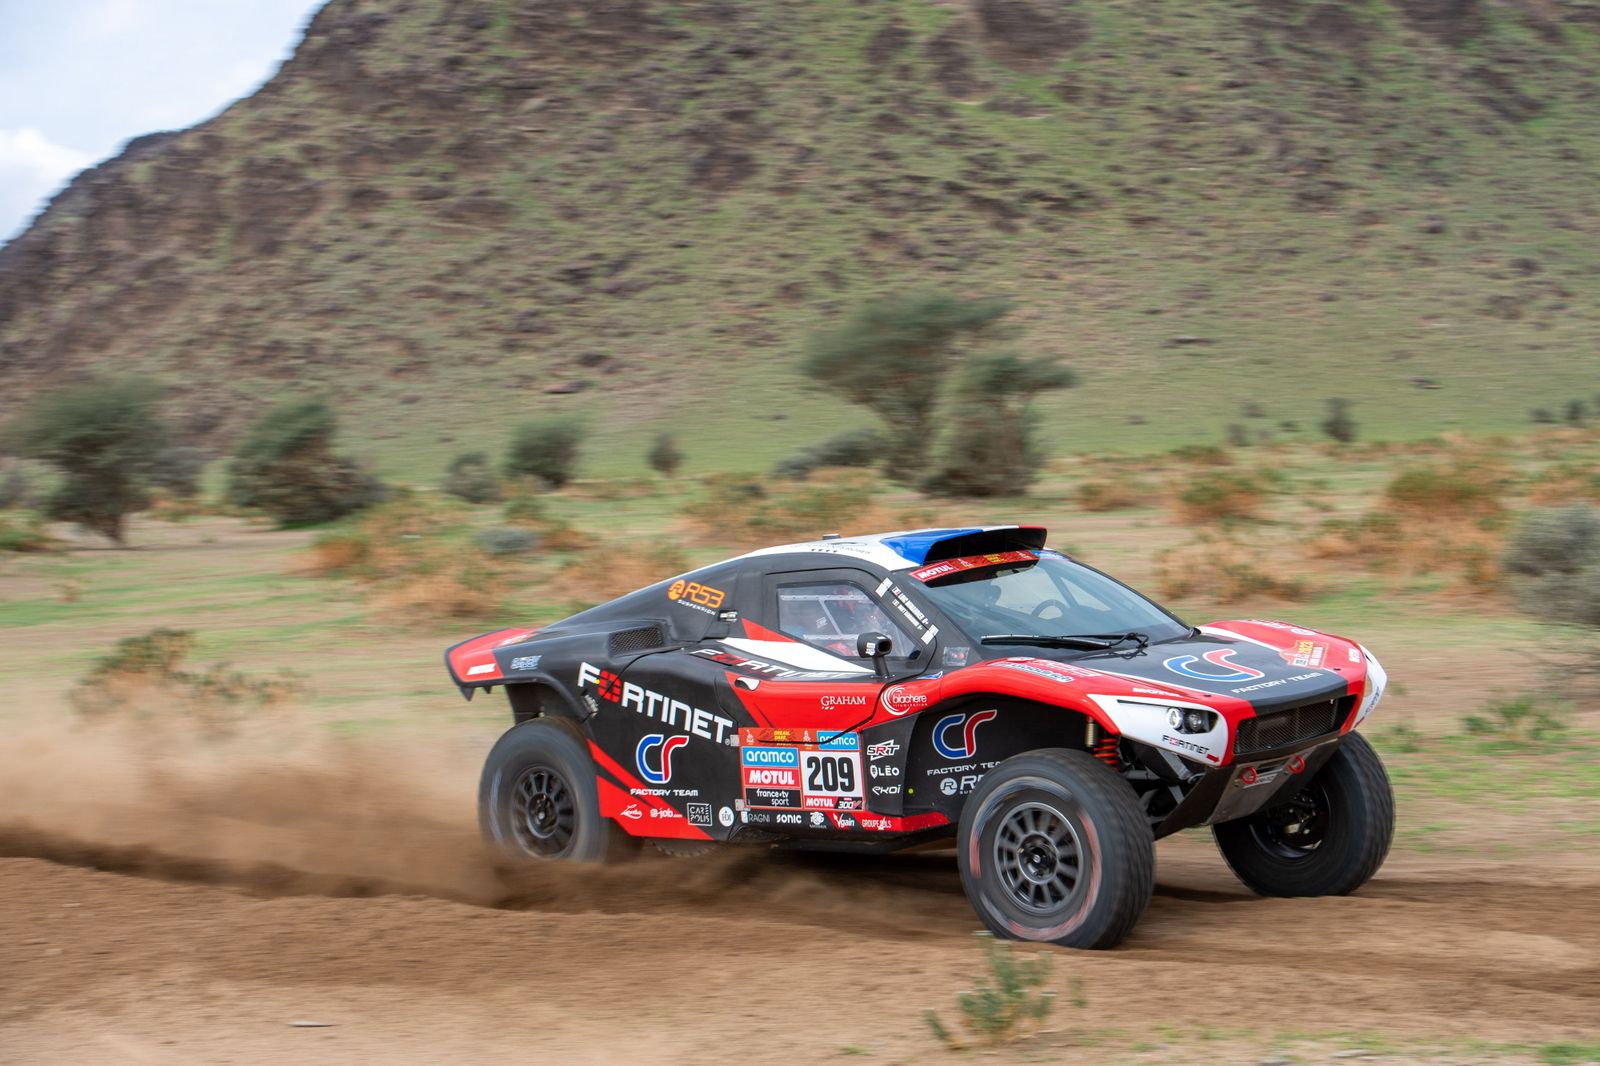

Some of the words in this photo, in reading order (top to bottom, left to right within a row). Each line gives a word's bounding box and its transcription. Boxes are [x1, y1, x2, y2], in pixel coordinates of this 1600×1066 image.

[917, 564, 954, 579] MOTUL
[677, 599, 717, 616] SUSPENSION
[1230, 679, 1287, 694] FACTORY
[1287, 671, 1324, 684] TEAM
[577, 661, 734, 745] FORTINET
[820, 696, 867, 706] GRAHAM
[867, 744, 900, 756] SRT
[1162, 735, 1209, 755] FORTINET
[746, 750, 795, 763] aramco
[806, 756, 856, 793] 209
[926, 763, 978, 777] FACTORY
[749, 770, 795, 785] MOTUL
[630, 788, 671, 797] FACTORY
[672, 789, 699, 797] TEAM
[771, 797, 789, 806] sport
[806, 798, 834, 807] MOTUL
[748, 813, 771, 823] RAGNI
